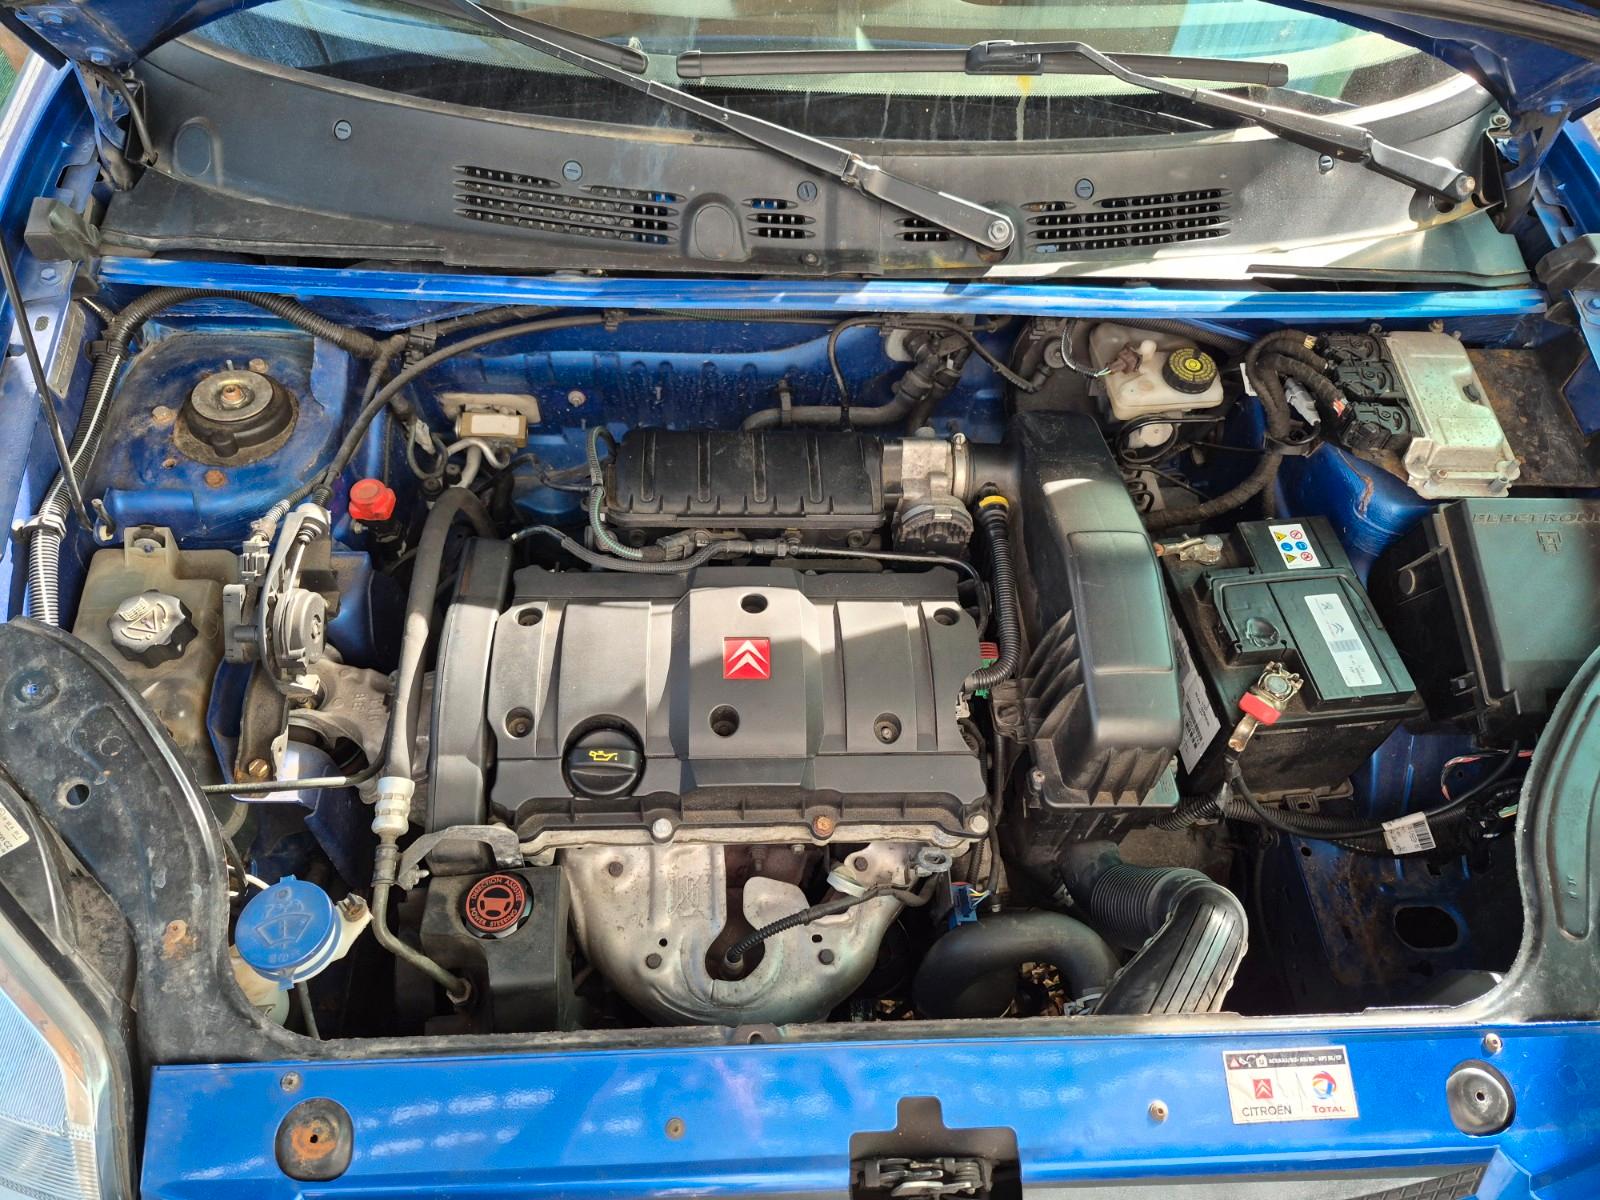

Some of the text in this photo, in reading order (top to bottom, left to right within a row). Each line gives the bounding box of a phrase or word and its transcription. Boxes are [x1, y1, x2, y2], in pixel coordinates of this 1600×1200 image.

[1472, 512, 1600, 525] ELECTRON
[471, 877, 502, 899] DIRECTION
[489, 909, 518, 927] STEERING
[1312, 1105, 1346, 1114] TOTAL
